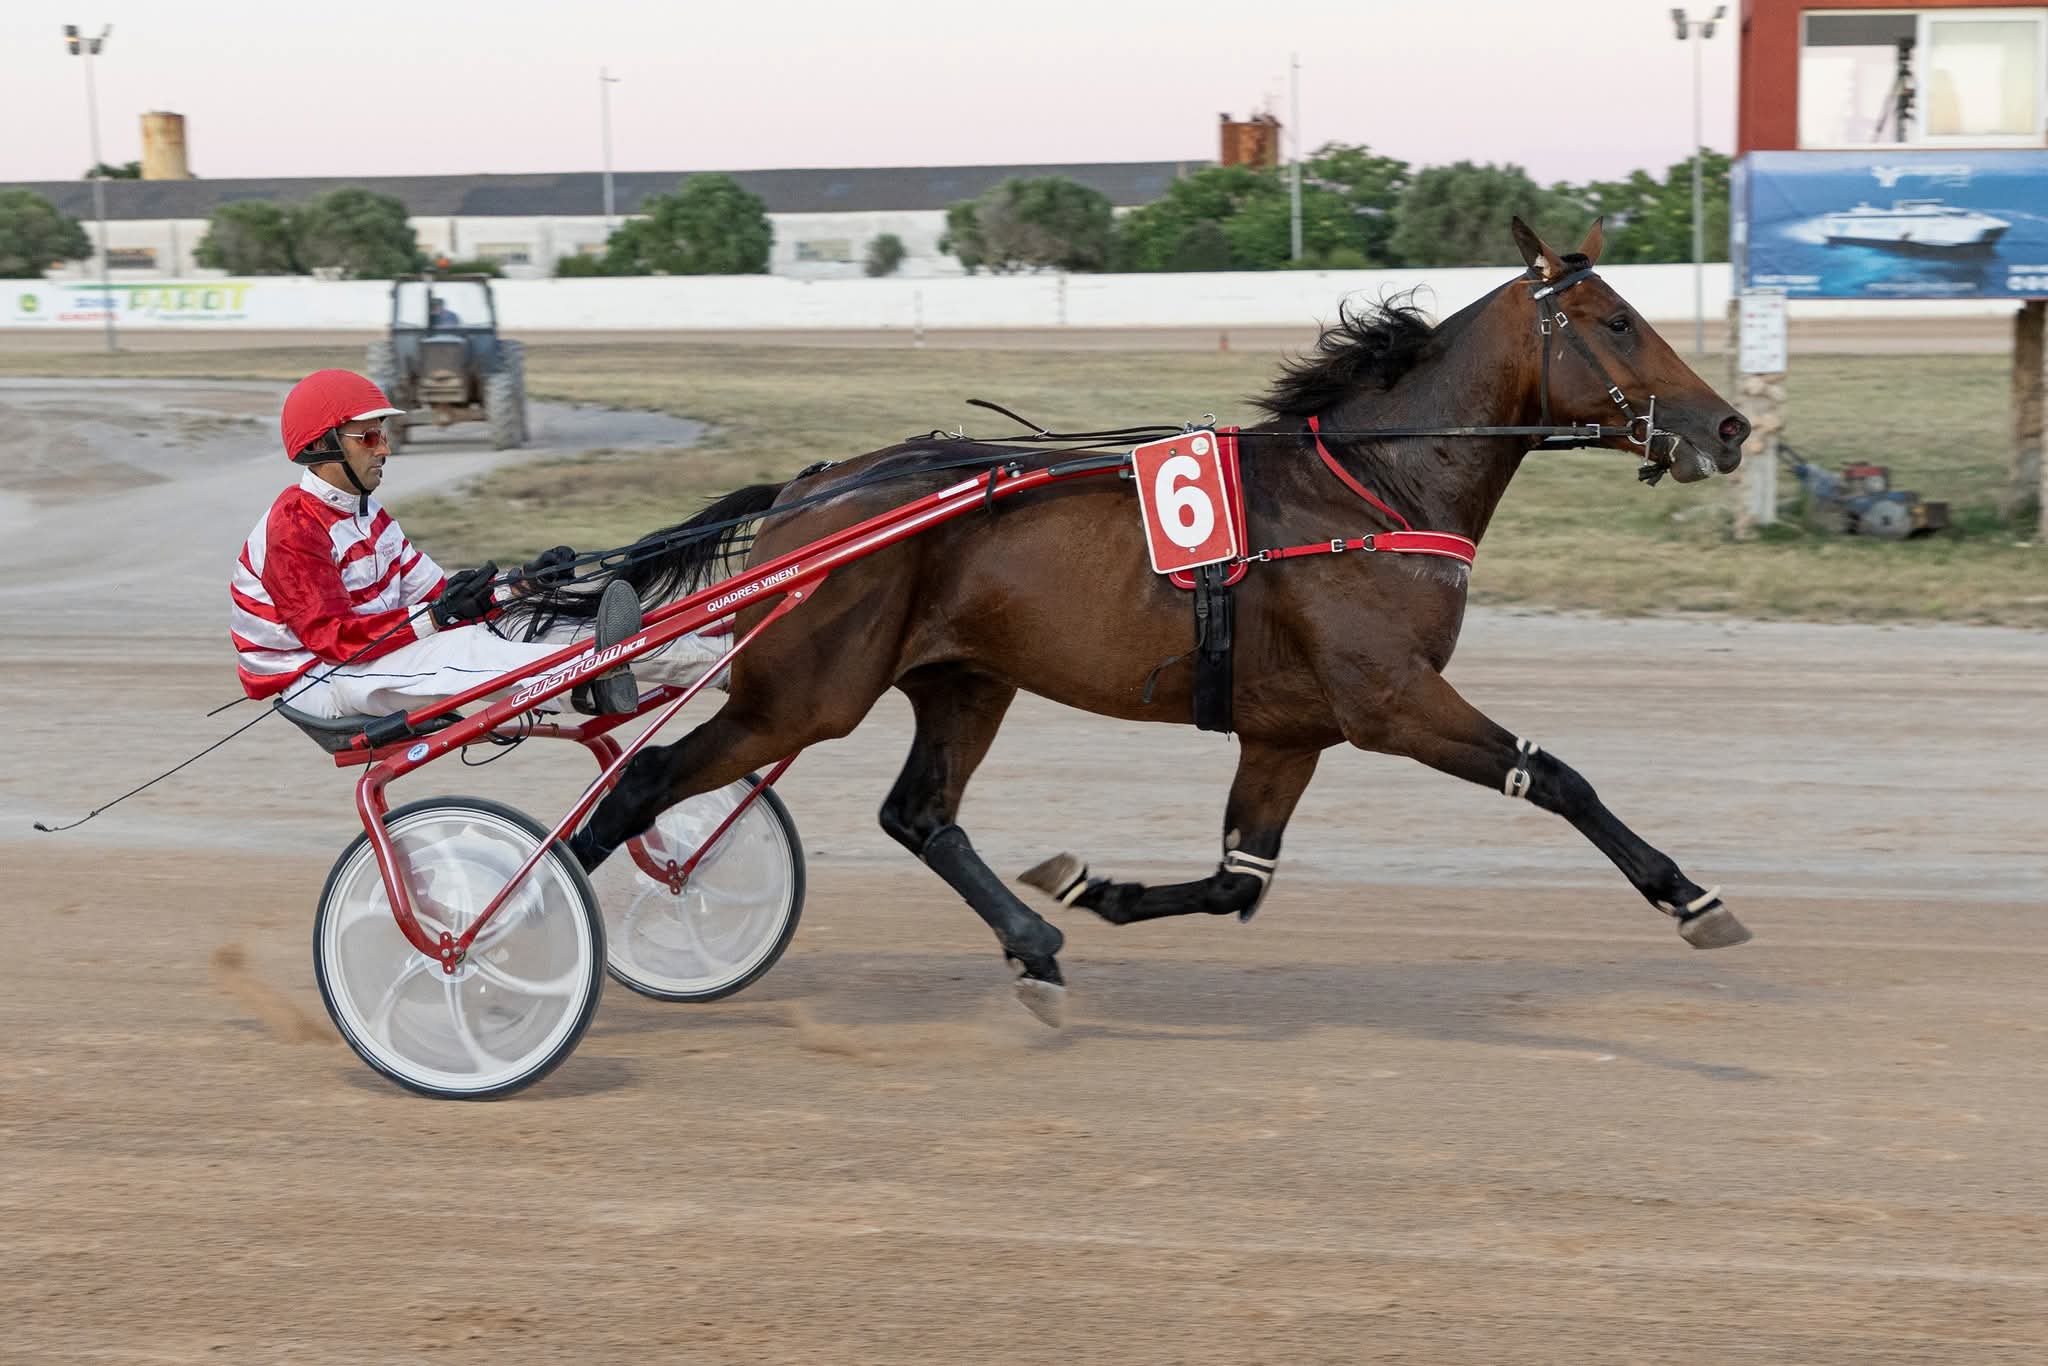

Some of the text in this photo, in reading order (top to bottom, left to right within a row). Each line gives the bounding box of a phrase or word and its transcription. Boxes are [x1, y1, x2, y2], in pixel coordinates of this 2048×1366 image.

[1155, 455, 1215, 548] 6
[707, 565, 800, 613] QUADRES VINENT
[511, 644, 622, 707] CUSTOM
